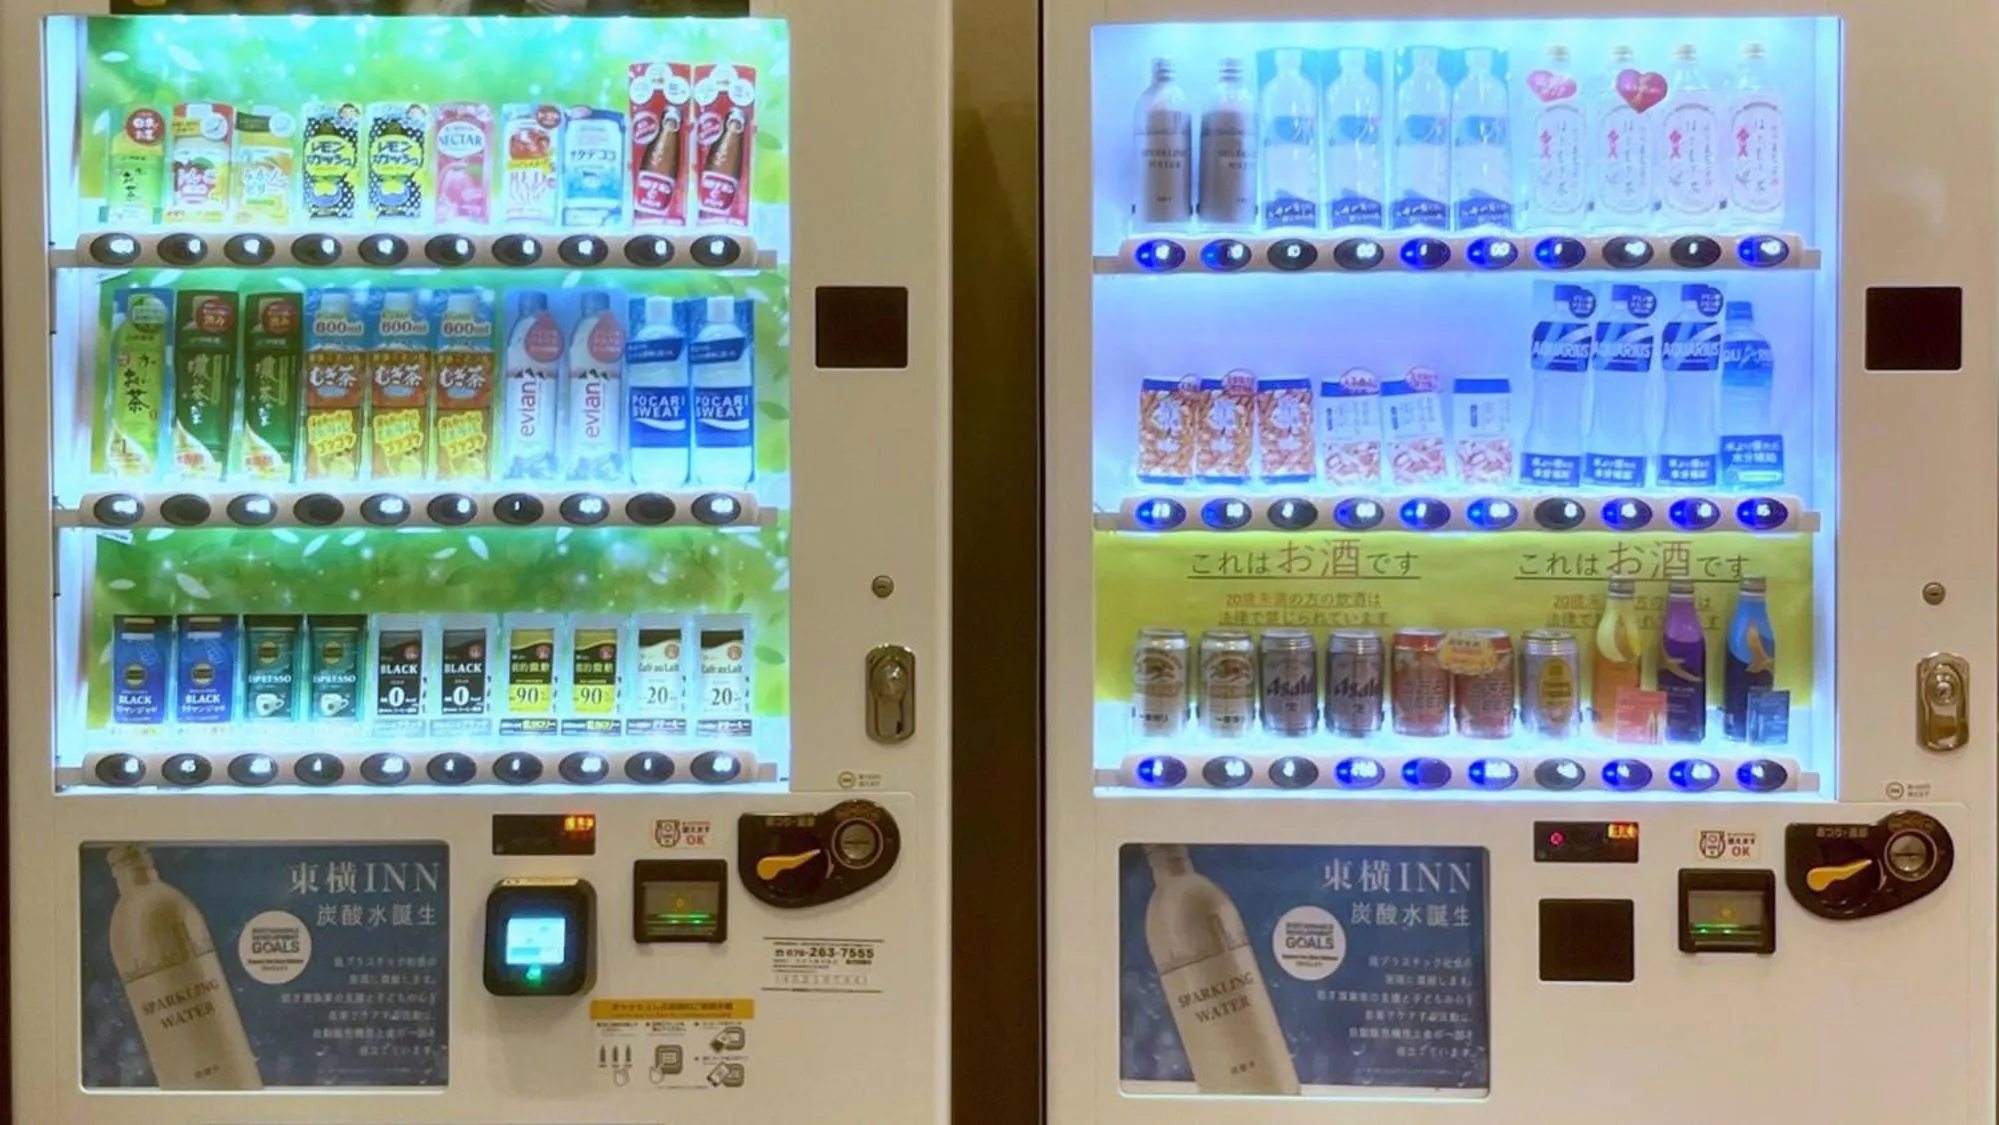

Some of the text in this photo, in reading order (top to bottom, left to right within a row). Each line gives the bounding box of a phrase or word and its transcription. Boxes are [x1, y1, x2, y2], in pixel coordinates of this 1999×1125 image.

[311, 141, 345, 153] レモン
[378, 141, 413, 153] レモン
[310, 363, 358, 386] むぎ茶
[375, 363, 423, 386] むぎ茶
[440, 364, 486, 387] むぎ茶
[520, 376, 537, 437] evian
[585, 377, 601, 438] evian
[632, 394, 686, 406] POCARI
[696, 394, 749, 406] POCARI
[632, 406, 680, 417] SWEAT
[696, 406, 744, 417] SWEAT
[1191, 538, 1419, 577] これはお酒です
[1519, 540, 1751, 578] これはお酒です
[380, 664, 418, 675] BLACK
[443, 662, 482, 674] BLACK
[453, 685, 470, 706] 0
[516, 687, 539, 704] 90
[580, 686, 603, 705] 90
[646, 686, 669, 705] 20
[1266, 675, 1314, 696] Asahi
[1333, 676, 1381, 697] Asahi
[118, 694, 153, 705] BLACK
[184, 693, 221, 704] BLACK
[388, 686, 405, 707] 0
[711, 687, 733, 706] 20
[686, 835, 706, 845] OK
[1731, 846, 1751, 857] OK
[289, 861, 440, 895] 東横INN
[1322, 857, 1473, 893] 東横INN
[316, 903, 437, 927] 炭酸水誕生
[1350, 902, 1472, 927] 炭酸水誕生
[251, 941, 300, 954] GOALS
[1286, 936, 1335, 950] GOALS
[142, 978, 221, 1016] SPARKLING
[1177, 971, 1254, 1010] SPARKLING
[160, 1001, 216, 1030] WATER
[1194, 994, 1251, 1024] WATER
